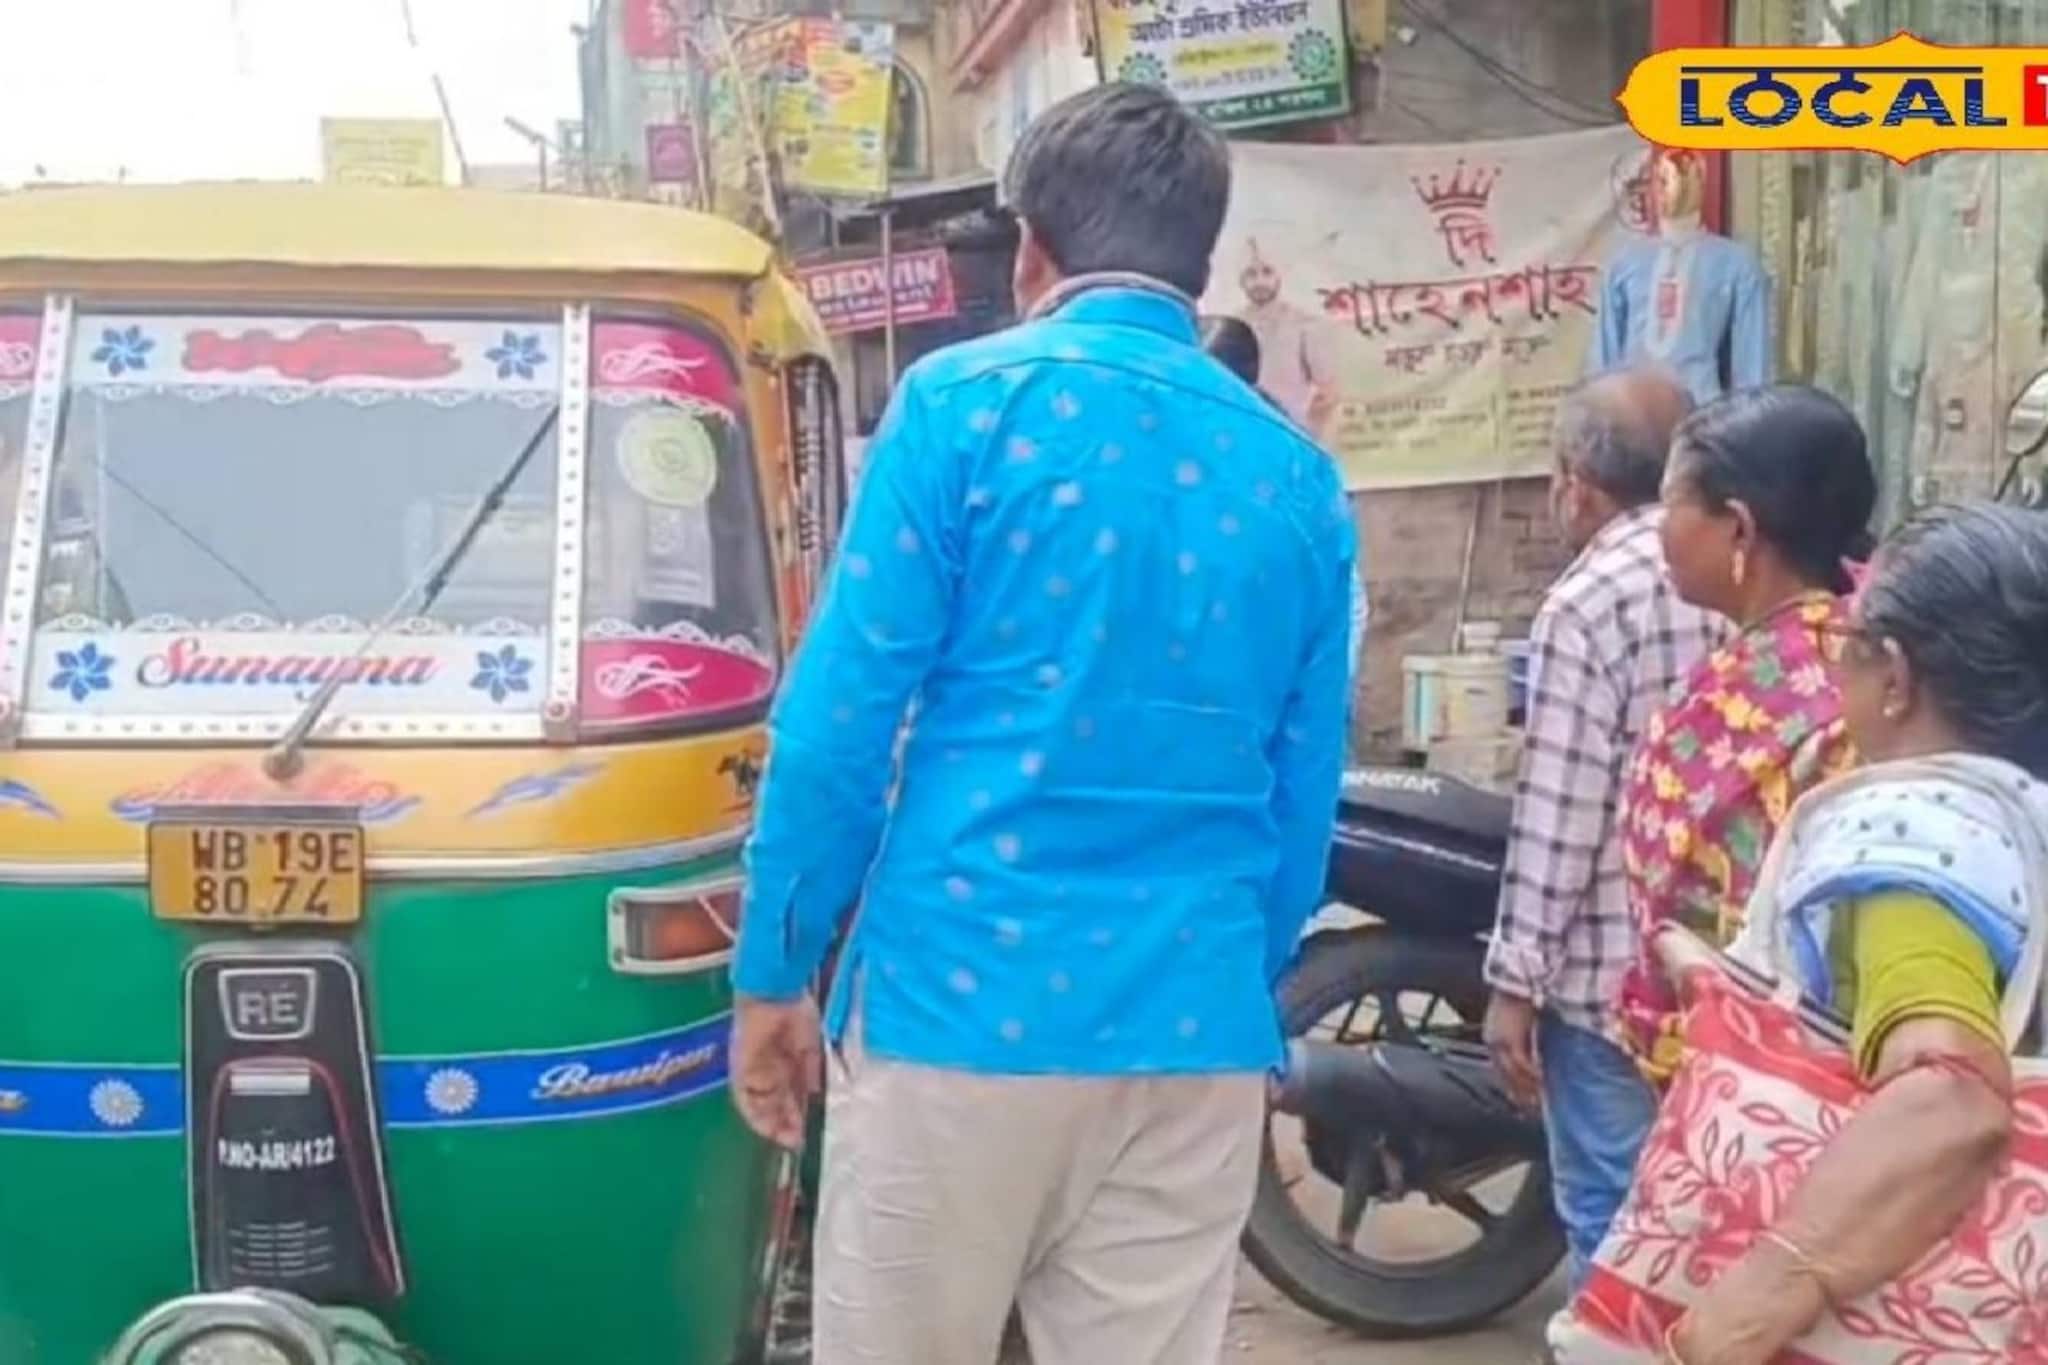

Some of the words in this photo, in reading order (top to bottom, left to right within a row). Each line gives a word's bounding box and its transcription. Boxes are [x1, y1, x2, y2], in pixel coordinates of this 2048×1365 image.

[137, 637, 436, 701] Sunayna
[193, 829, 249, 871] WB
[273, 831, 353, 874] 19E
[237, 992, 299, 1025] RE
